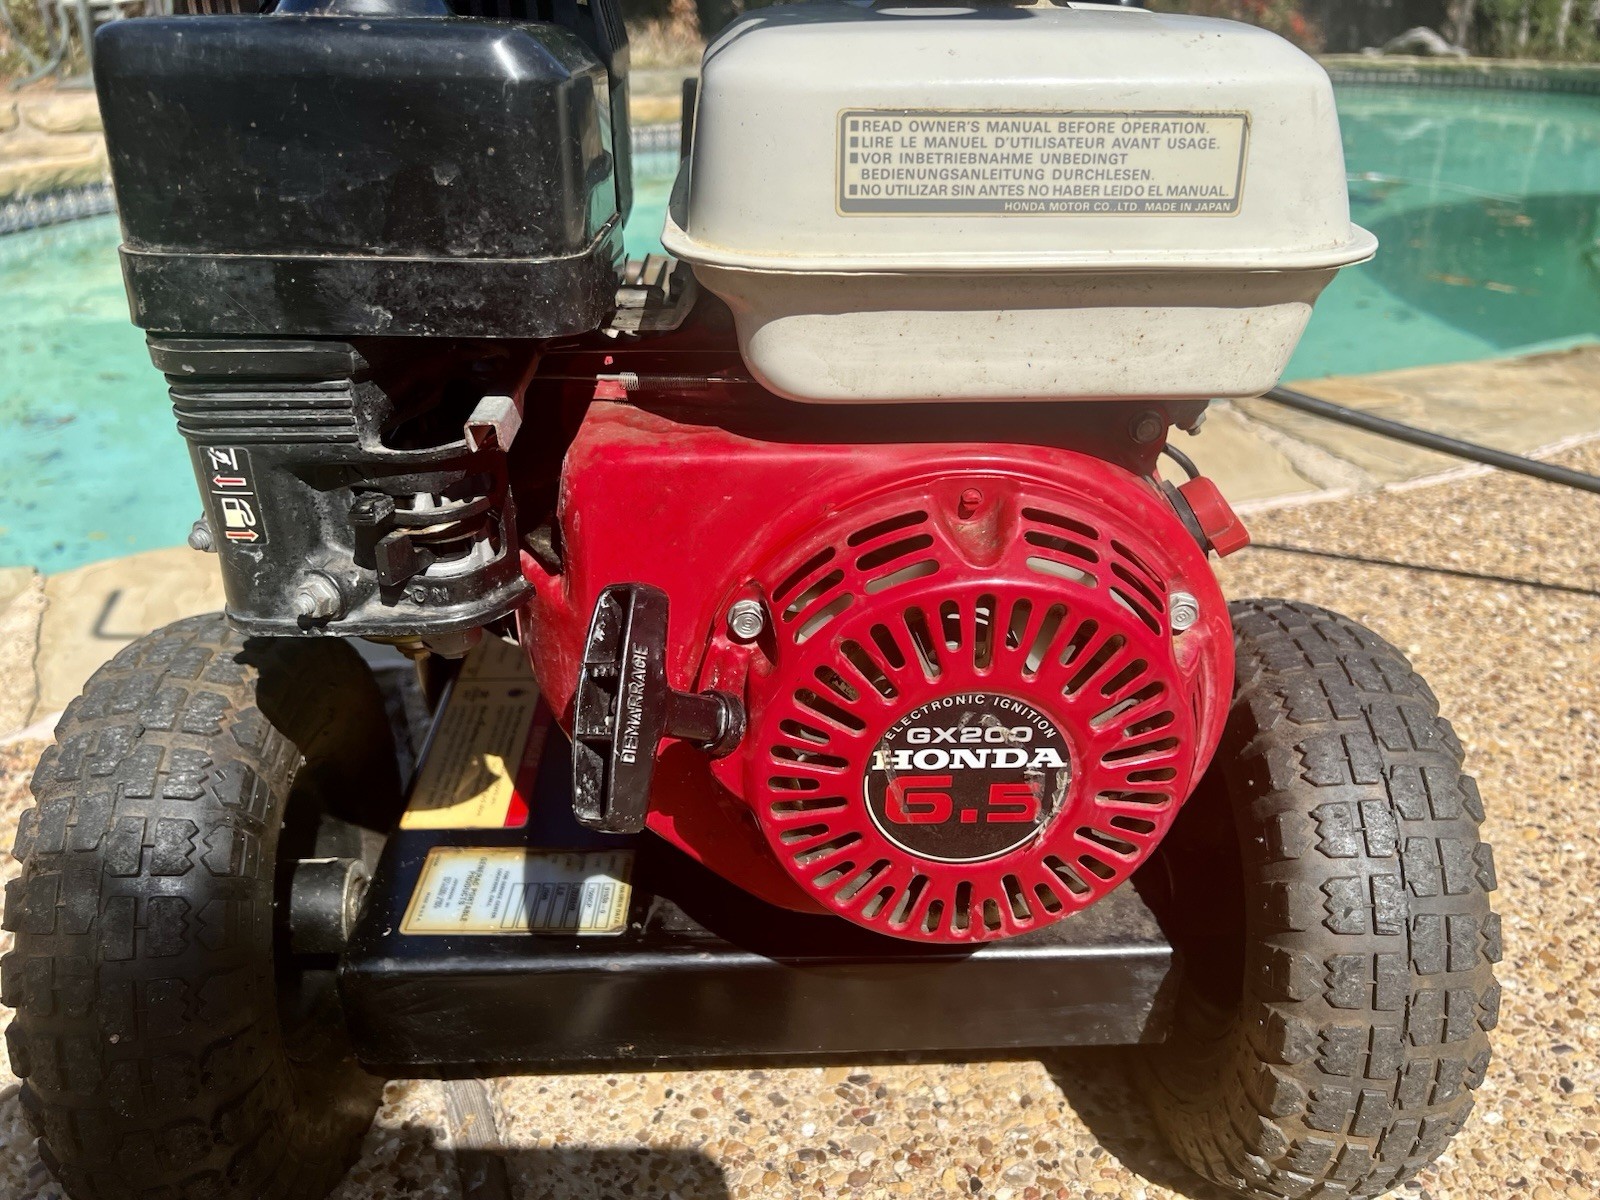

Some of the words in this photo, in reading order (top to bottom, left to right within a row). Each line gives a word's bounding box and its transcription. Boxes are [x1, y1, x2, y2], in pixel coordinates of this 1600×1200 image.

[862, 120, 902, 133] READ
[909, 120, 980, 133] OWNER'S
[987, 120, 1051, 133] MANUAL
[1058, 120, 1115, 133] BEFORE
[1122, 120, 1210, 133] OPERATION.
[862, 137, 893, 150] LIRE
[901, 137, 917, 150] LE
[924, 137, 988, 150] MANUEL
[995, 137, 1105, 150] D'UTILISATEUR
[1112, 137, 1160, 150] AVANT
[1167, 137, 1221, 150] USAGE.
[861, 152, 892, 165] VOR
[900, 152, 1033, 165] INBETRIEBNAHME
[1040, 152, 1128, 165] UNBEDINGT
[861, 168, 1045, 181] BEDIENUNGSANLEITUNG
[1052, 168, 1155, 181] DURCHLESEN.
[861, 184, 881, 197] NO
[885, 184, 947, 197] UTILIZAR
[951, 184, 974, 197] SIN
[978, 184, 1024, 197] ANTES
[1029, 184, 1049, 197] NO
[1053, 184, 1099, 197] HABER
[1103, 184, 1144, 197] LEIDO
[1148, 184, 1164, 197] EL
[1167, 184, 1229, 197] MANUAL.
[1004, 201, 1046, 213] HONDA
[1049, 201, 1090, 213] MOTOR
[1145, 201, 1178, 213] MADE
[1180, 201, 1192, 213] IN
[1195, 201, 1231, 213] JAPAN
[885, 694, 985, 741] ELECTRONIC
[993, 697, 1057, 739] IGNITION
[907, 726, 1033, 743] GX200
[872, 748, 1067, 770] HONDA
[885, 775, 1042, 824] 6.5
